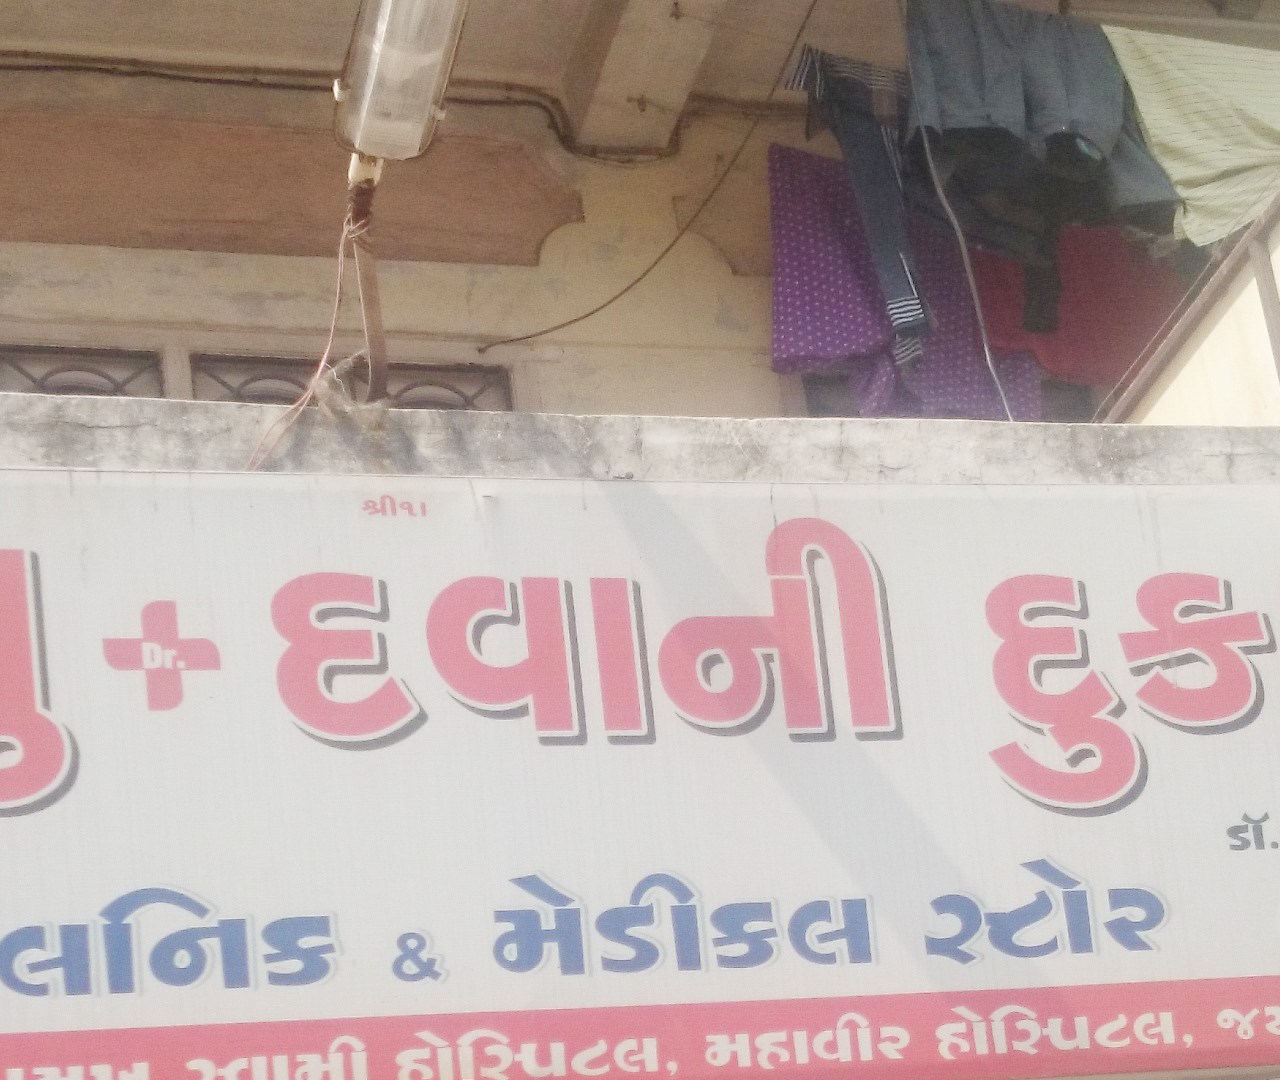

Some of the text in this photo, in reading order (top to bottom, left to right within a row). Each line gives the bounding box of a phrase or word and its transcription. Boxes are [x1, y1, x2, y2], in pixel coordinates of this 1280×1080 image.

[270, 517, 904, 751] દવાની
[391, 932, 446, 983] &
[493, 872, 876, 977] મેડીકલ
[923, 858, 1168, 965] સ્ટોર
[705, 1012, 911, 1069] મહાવીર
[936, 1002, 1194, 1062] હોસ્પિટલ,
